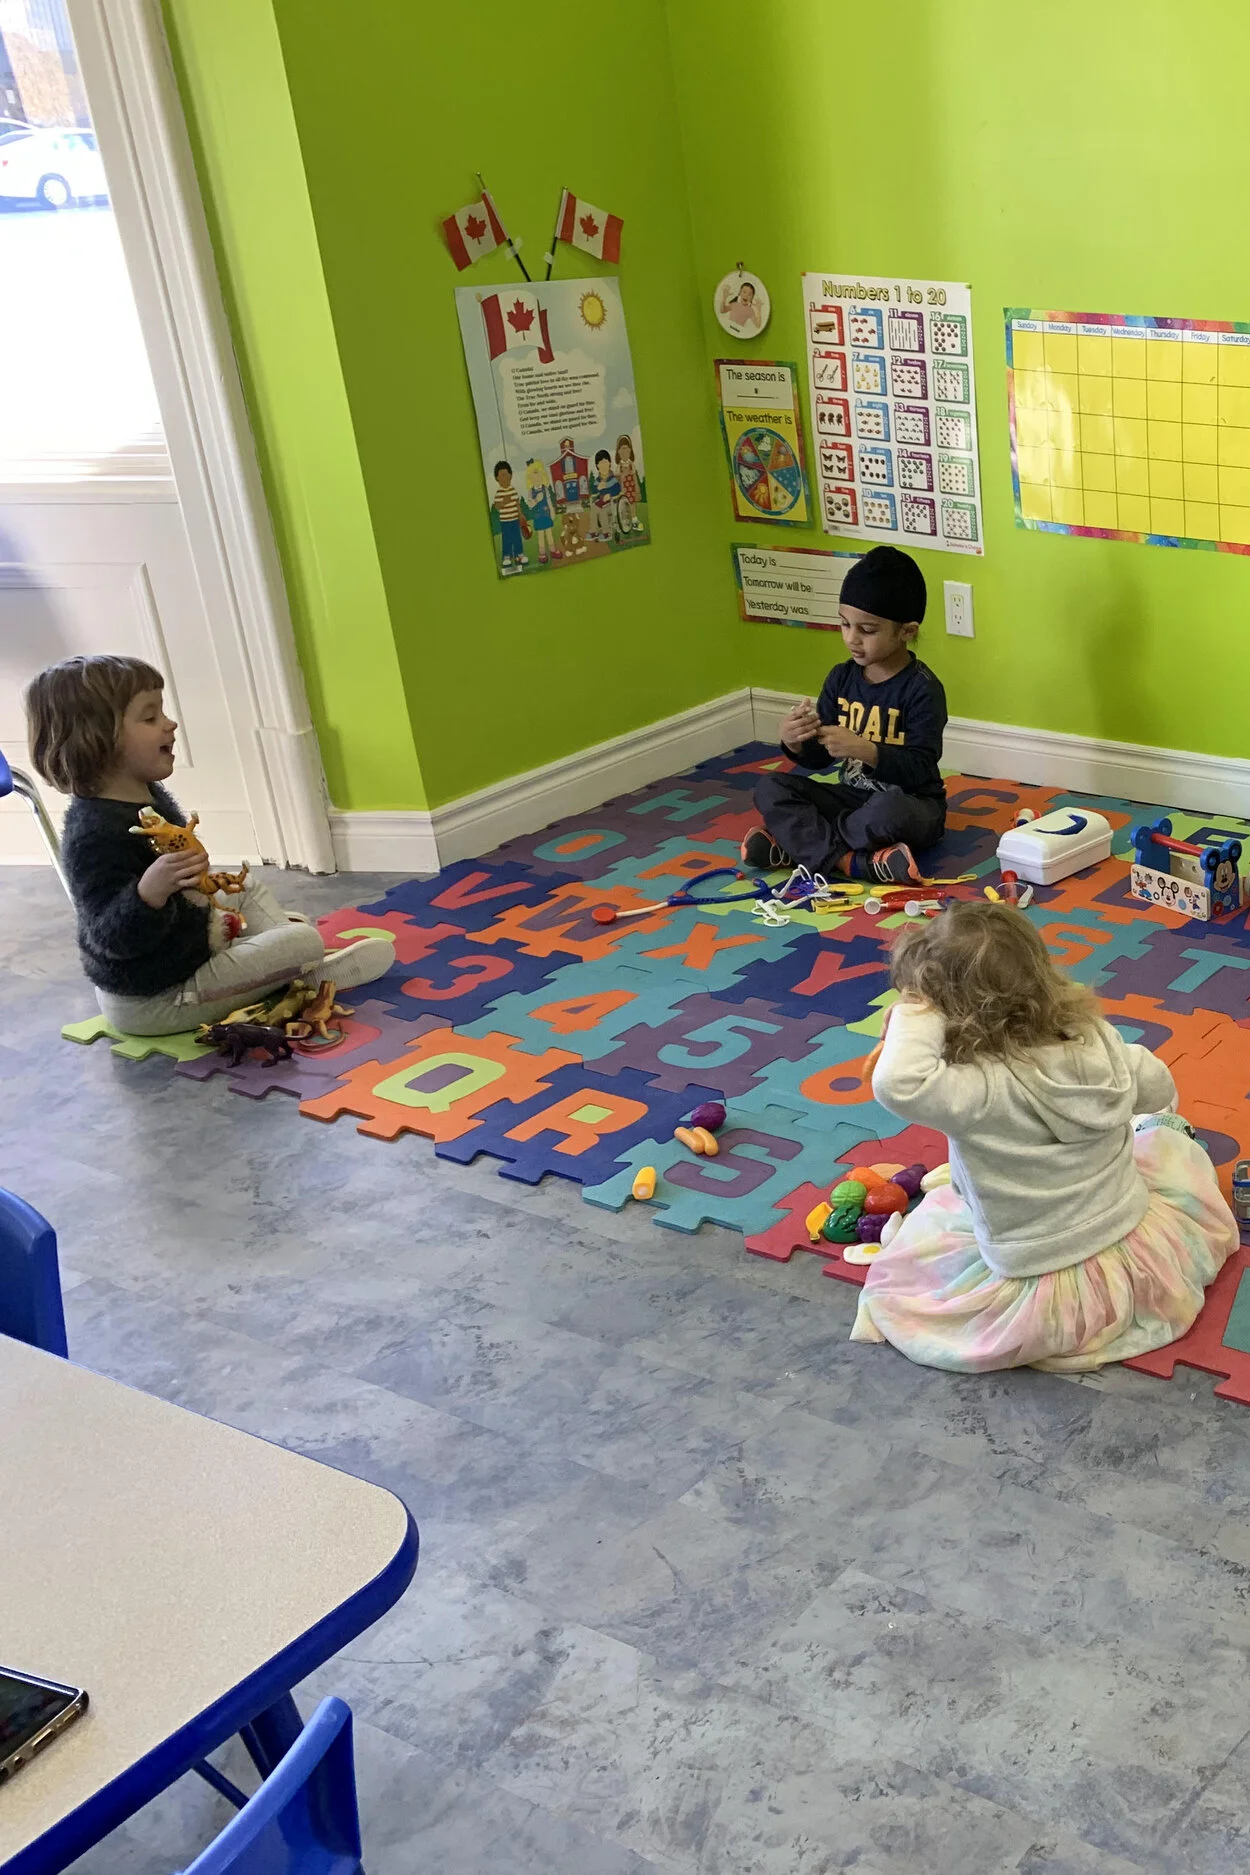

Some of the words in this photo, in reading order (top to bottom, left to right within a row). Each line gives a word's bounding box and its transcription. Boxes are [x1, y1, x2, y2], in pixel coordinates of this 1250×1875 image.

[822, 280, 889, 301] Numbers
[894, 285, 901, 302] 1
[907, 286, 923, 303] to
[927, 288, 946, 306] 20
[810, 302, 815, 311] 1
[888, 308, 899, 318] 11
[930, 312, 941, 321] 16
[1017, 321, 1037, 330] Sunday
[1048, 323, 1072, 333] Monday
[1082, 325, 1107, 335] Tuesday
[1112, 327, 1145, 338] Wednesday
[1150, 329, 1180, 340] Thursday
[1191, 332, 1210, 342] Friday
[813, 348, 821, 358] 2
[853, 352, 860, 361] 7
[891, 356, 902, 365] 12
[933, 360, 945, 369] 17
[726, 369, 742, 381] The
[745, 371, 777, 381] season
[778, 372, 786, 382] is
[895, 402, 906, 412] 13
[936, 407, 947, 416] 18
[727, 411, 743, 422] The
[745, 412, 782, 424] weather
[785, 415, 793, 425] is
[820, 439, 828, 448] 4
[898, 449, 909, 458] 14
[938, 453, 949, 462] 19
[824, 483, 831, 492] 5
[862, 488, 873, 497] 10
[901, 493, 911, 502] 15
[942, 499, 953, 508] 20
[739, 553, 767, 568] Today
[769, 556, 777, 566] is
[743, 576, 784, 589] Tomorrow
[785, 581, 800, 592] will
[746, 599, 789, 615] Yesterday
[790, 606, 809, 615] was
[838, 697, 905, 745] GOAL
[626, 789, 730, 821] H
[636, 850, 738, 880] P
[429, 871, 536, 910] V
[516, 895, 658, 942] W
[636, 923, 769, 971] X
[401, 955, 515, 1000] 3
[790, 951, 891, 996] Y
[527, 990, 640, 1035] 4
[656, 1015, 786, 1070] 5
[371, 1052, 508, 1114] Q
[504, 1088, 649, 1155] R
[663, 1127, 803, 1198] S
